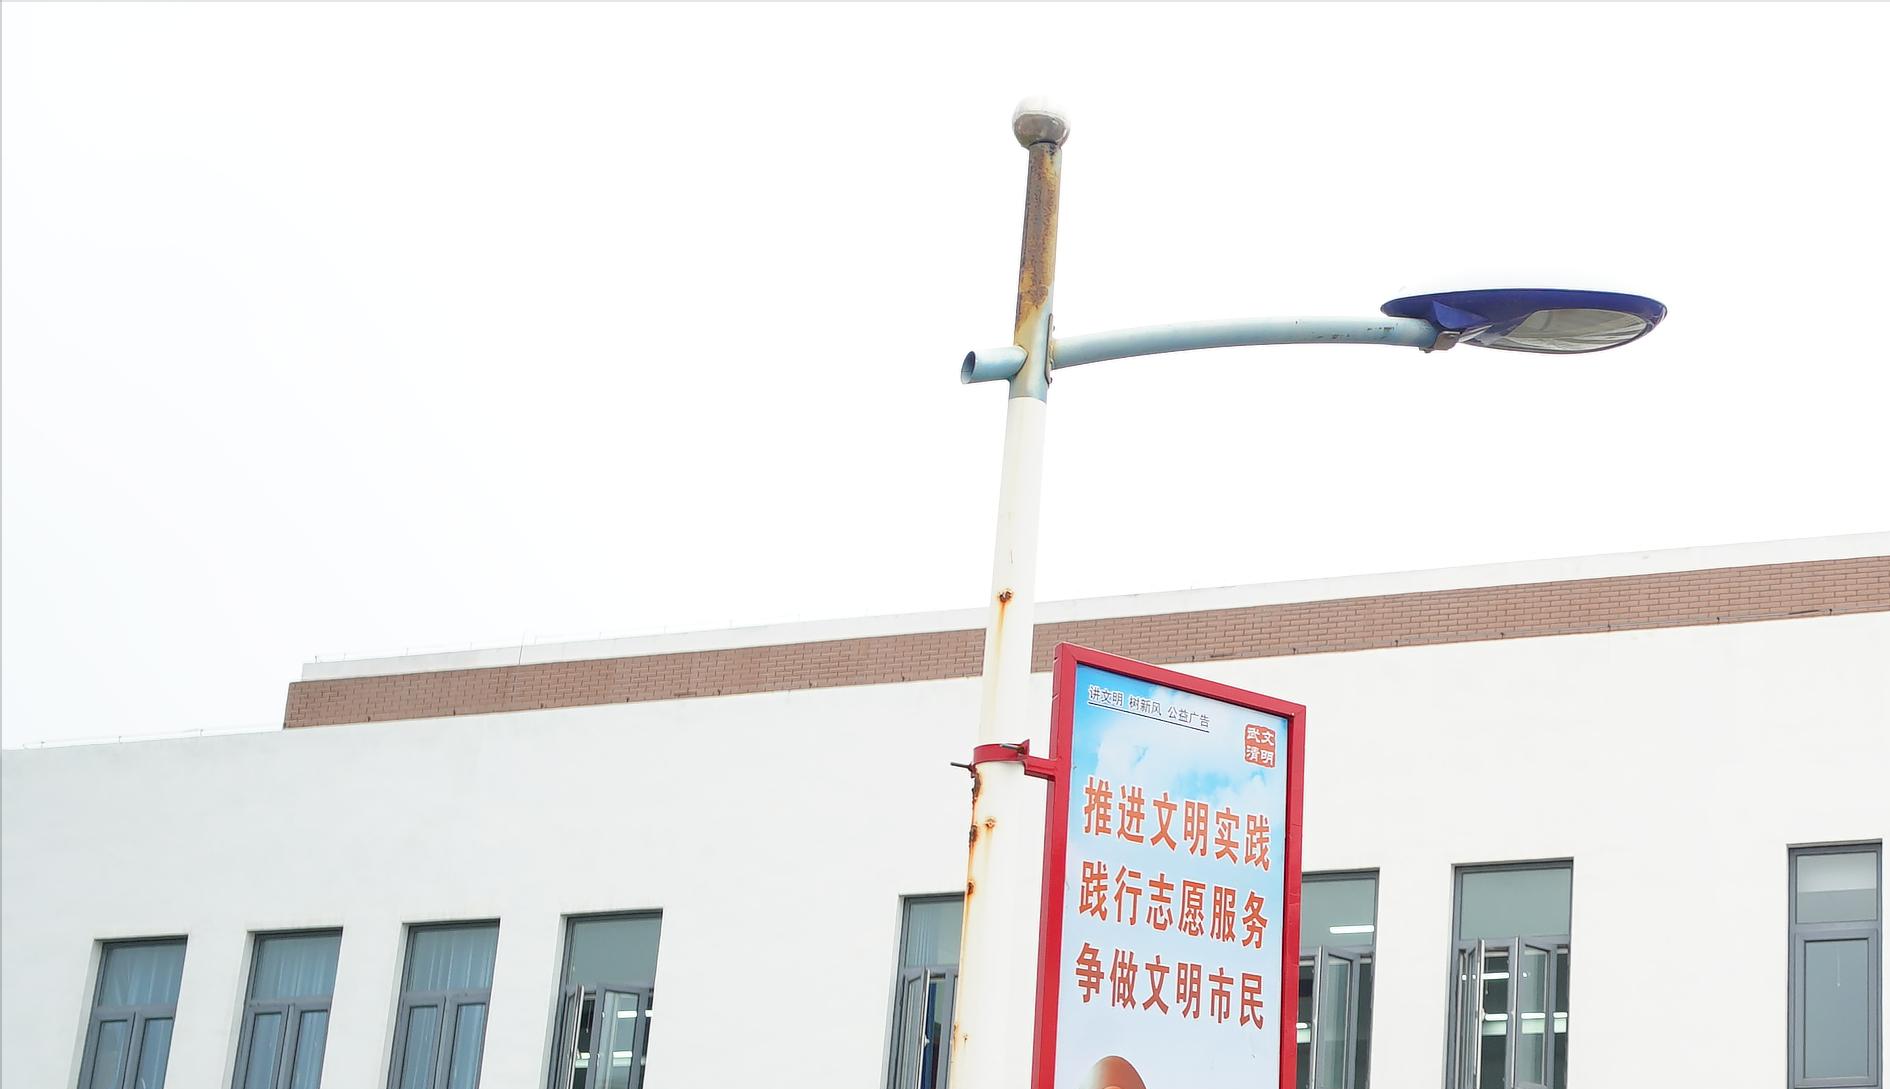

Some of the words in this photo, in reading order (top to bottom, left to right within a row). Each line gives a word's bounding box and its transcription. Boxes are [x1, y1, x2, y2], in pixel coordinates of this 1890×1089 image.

[1089, 685, 1123, 707] 讲文明
[1129, 695, 1162, 716] 树新风
[1167, 706, 1210, 728] 公益广告
[1083, 776, 1271, 872] 推进文明实践
[1078, 860, 1269, 950] 践行志愿服务
[1075, 942, 1265, 1030] 争做文明市民
